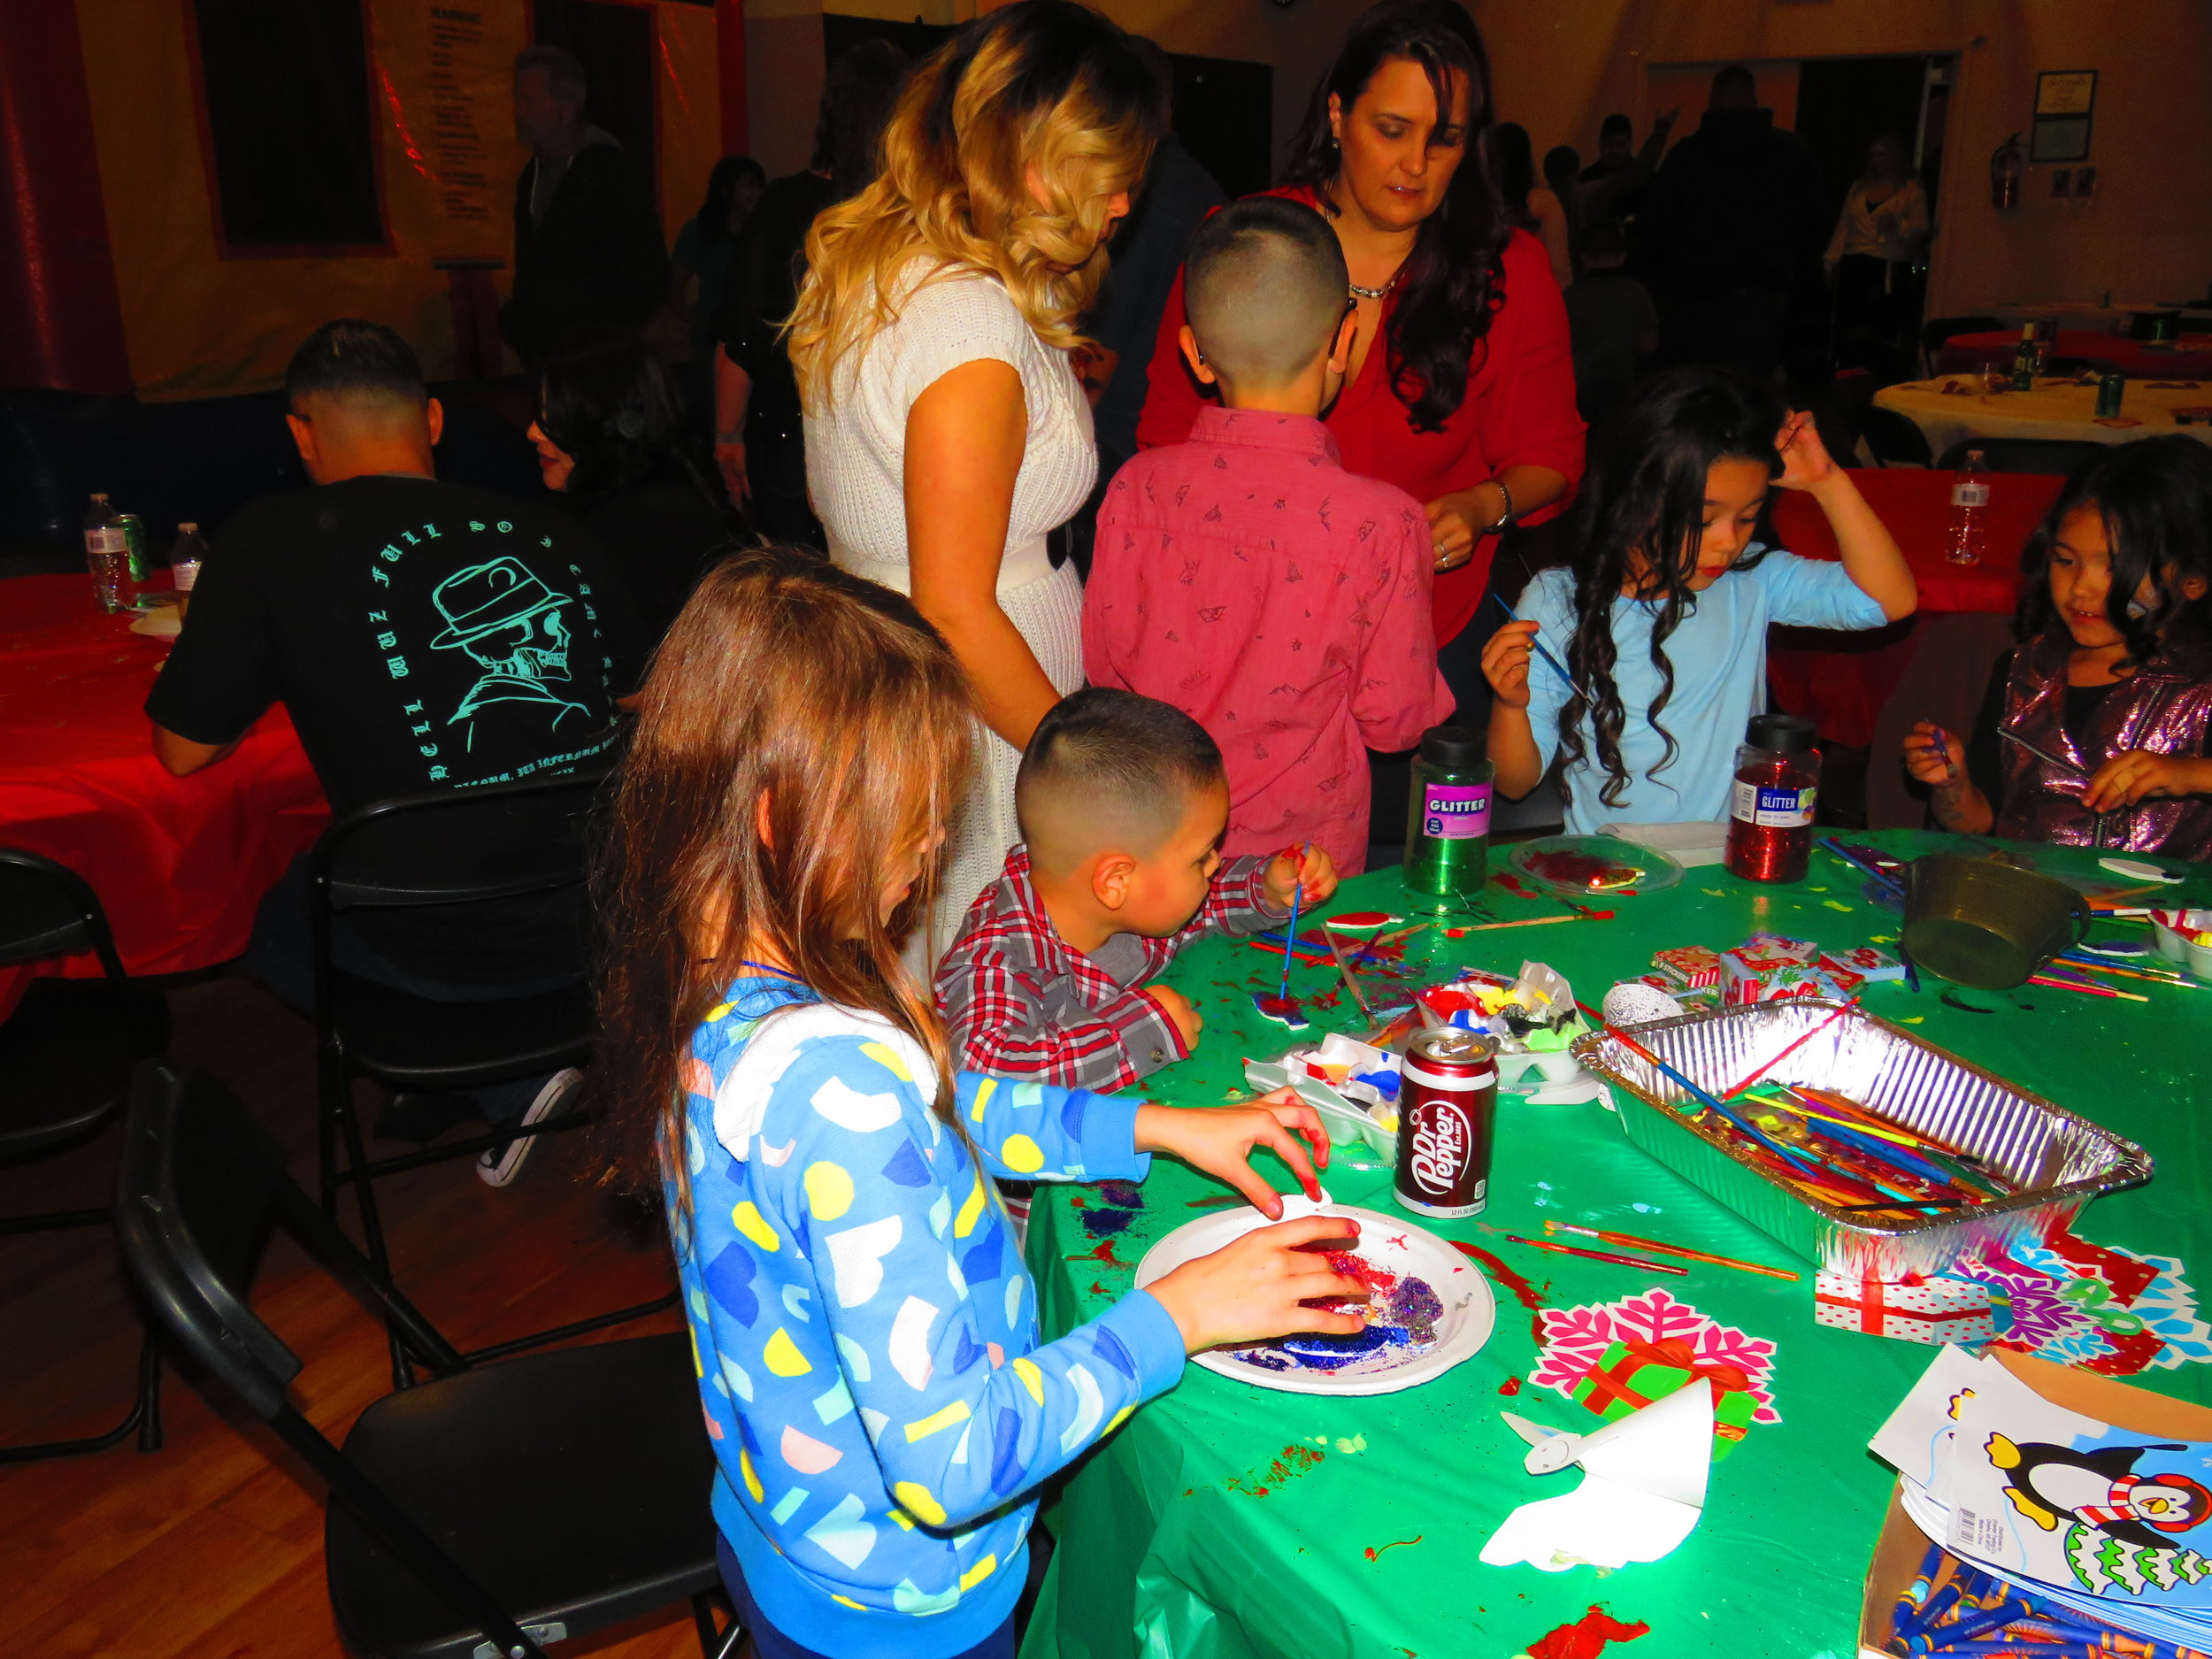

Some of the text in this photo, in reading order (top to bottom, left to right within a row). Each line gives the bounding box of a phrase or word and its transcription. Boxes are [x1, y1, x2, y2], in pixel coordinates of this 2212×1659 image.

[431, 7, 482, 25] WARNING
[1429, 798, 1486, 812] GLITTER
[1762, 796, 1796, 809] GLITTER
[1663, 964, 1690, 983] STICKERS
[1412, 1121, 1436, 1161] Dr
